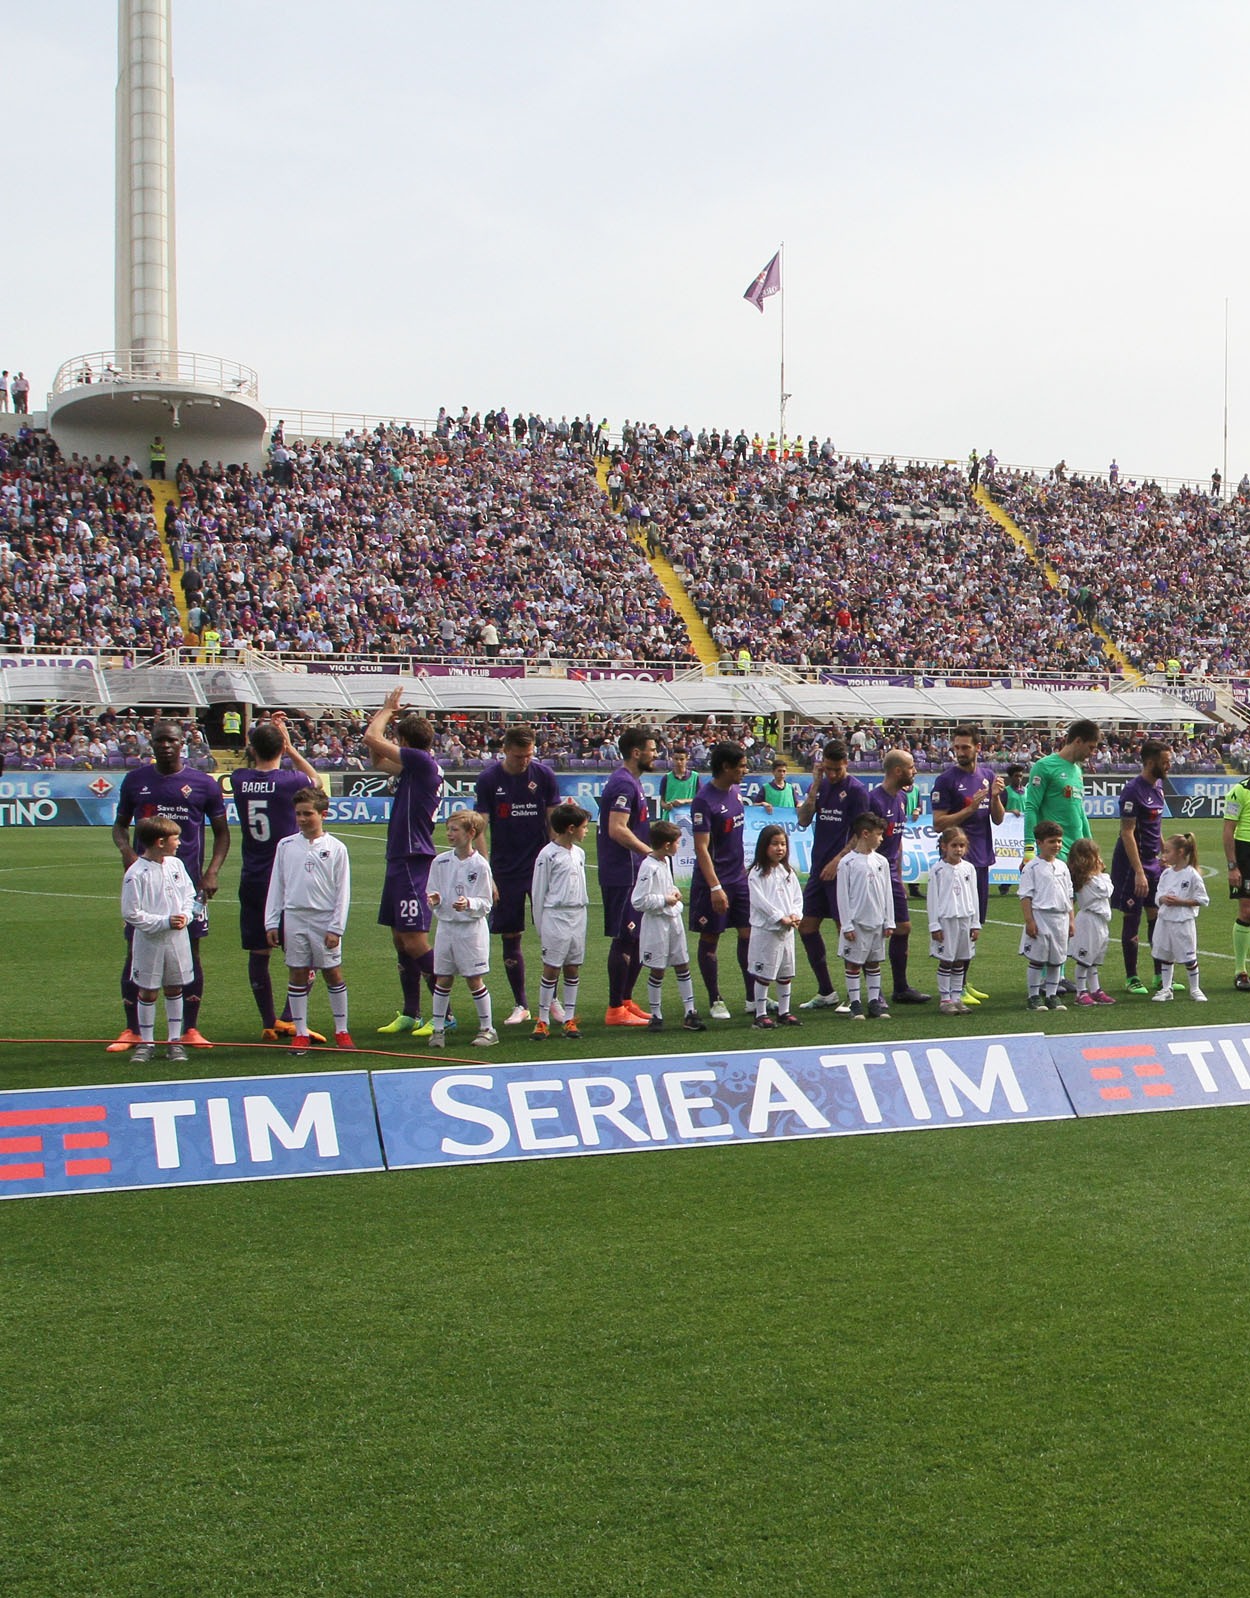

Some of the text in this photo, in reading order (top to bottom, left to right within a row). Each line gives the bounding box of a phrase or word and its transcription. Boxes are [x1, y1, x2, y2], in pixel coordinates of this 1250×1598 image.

[329, 664, 383, 673] VIOLA CLUB
[471, 668, 490, 677] CLUB
[242, 781, 276, 793] BADELJ
[157, 804, 188, 813] Save the
[511, 809, 538, 817] Children
[248, 800, 271, 842] 5
[400, 899, 418, 917] 28
[430, 1043, 1029, 1157] SERIE A TIM
[129, 1091, 341, 1170] TIM
